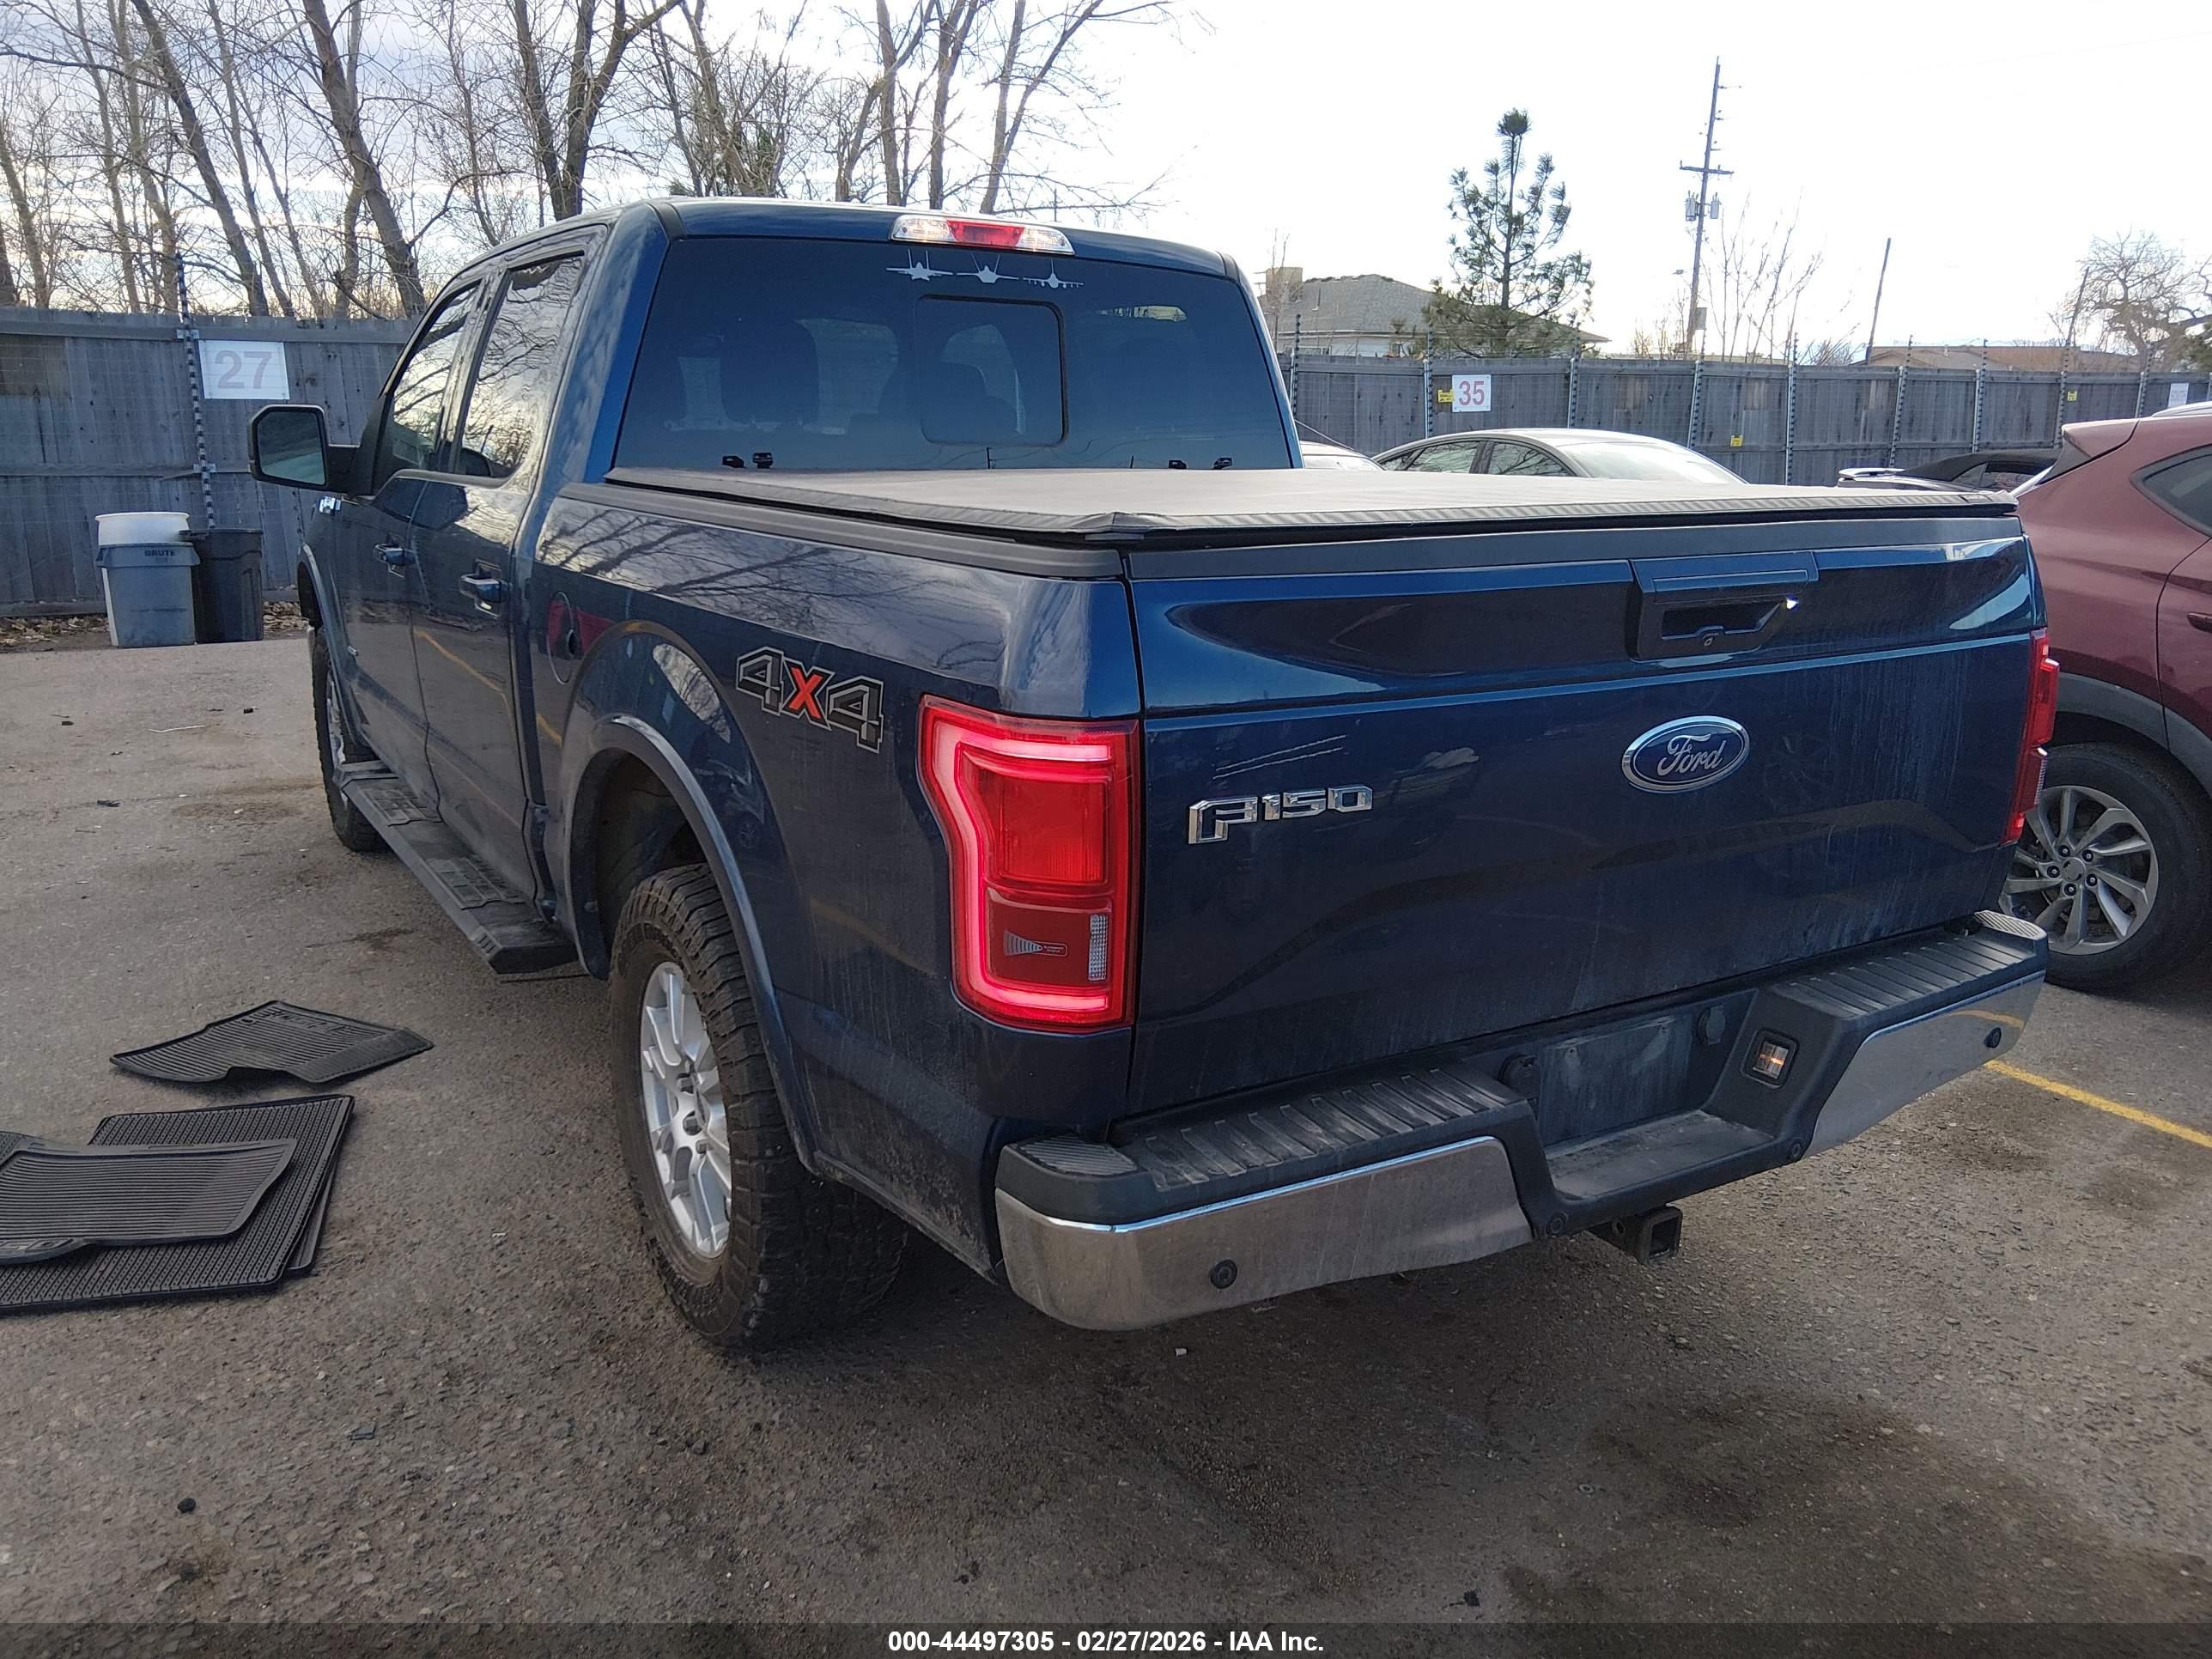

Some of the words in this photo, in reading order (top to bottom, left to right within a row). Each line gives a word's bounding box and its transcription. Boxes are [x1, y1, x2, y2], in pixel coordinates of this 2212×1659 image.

[215, 350, 272, 389] 27
[1458, 380, 1485, 405] 35
[736, 647, 884, 754] 4X4
[1657, 733, 1727, 776] Ford
[1188, 786, 1373, 844] F150
